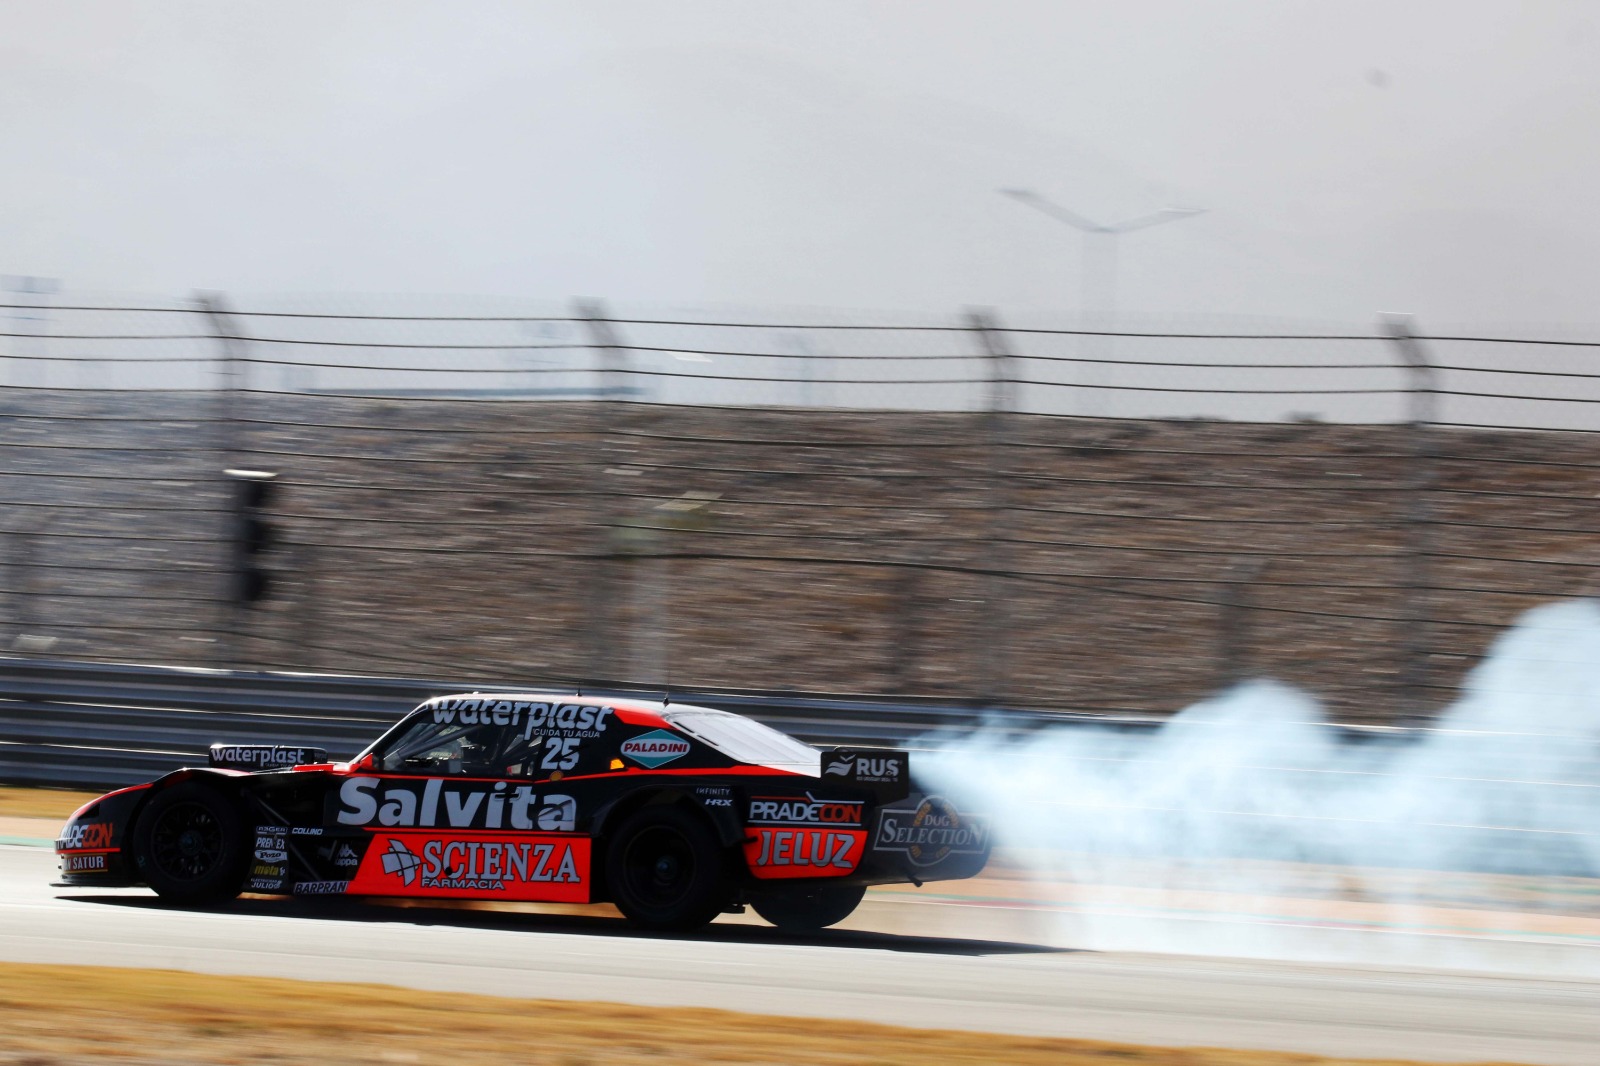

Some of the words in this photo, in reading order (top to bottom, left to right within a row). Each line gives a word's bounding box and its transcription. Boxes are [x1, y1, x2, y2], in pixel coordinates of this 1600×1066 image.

[432, 699, 614, 741] waterplast
[532, 728, 560, 736] CUIDA
[563, 729, 574, 737] TU
[575, 730, 600, 738] AGUA
[541, 737, 581, 770] 25
[623, 742, 689, 753] PALADINI
[211, 747, 304, 767] waterplast
[856, 758, 899, 777] RUS
[337, 777, 577, 831] Salvita
[705, 798, 733, 806] HRX
[749, 801, 862, 823] PRADECON
[924, 814, 950, 826] DOG
[292, 827, 323, 835] COLLINO
[881, 818, 985, 845] SELECTION
[757, 830, 856, 868] JELUZ
[72, 856, 104, 870] SATUR
[335, 859, 358, 867] appa
[422, 840, 581, 883] SCIENZA
[295, 882, 347, 894] BARPRAN
[421, 878, 505, 890] FARMACIA
